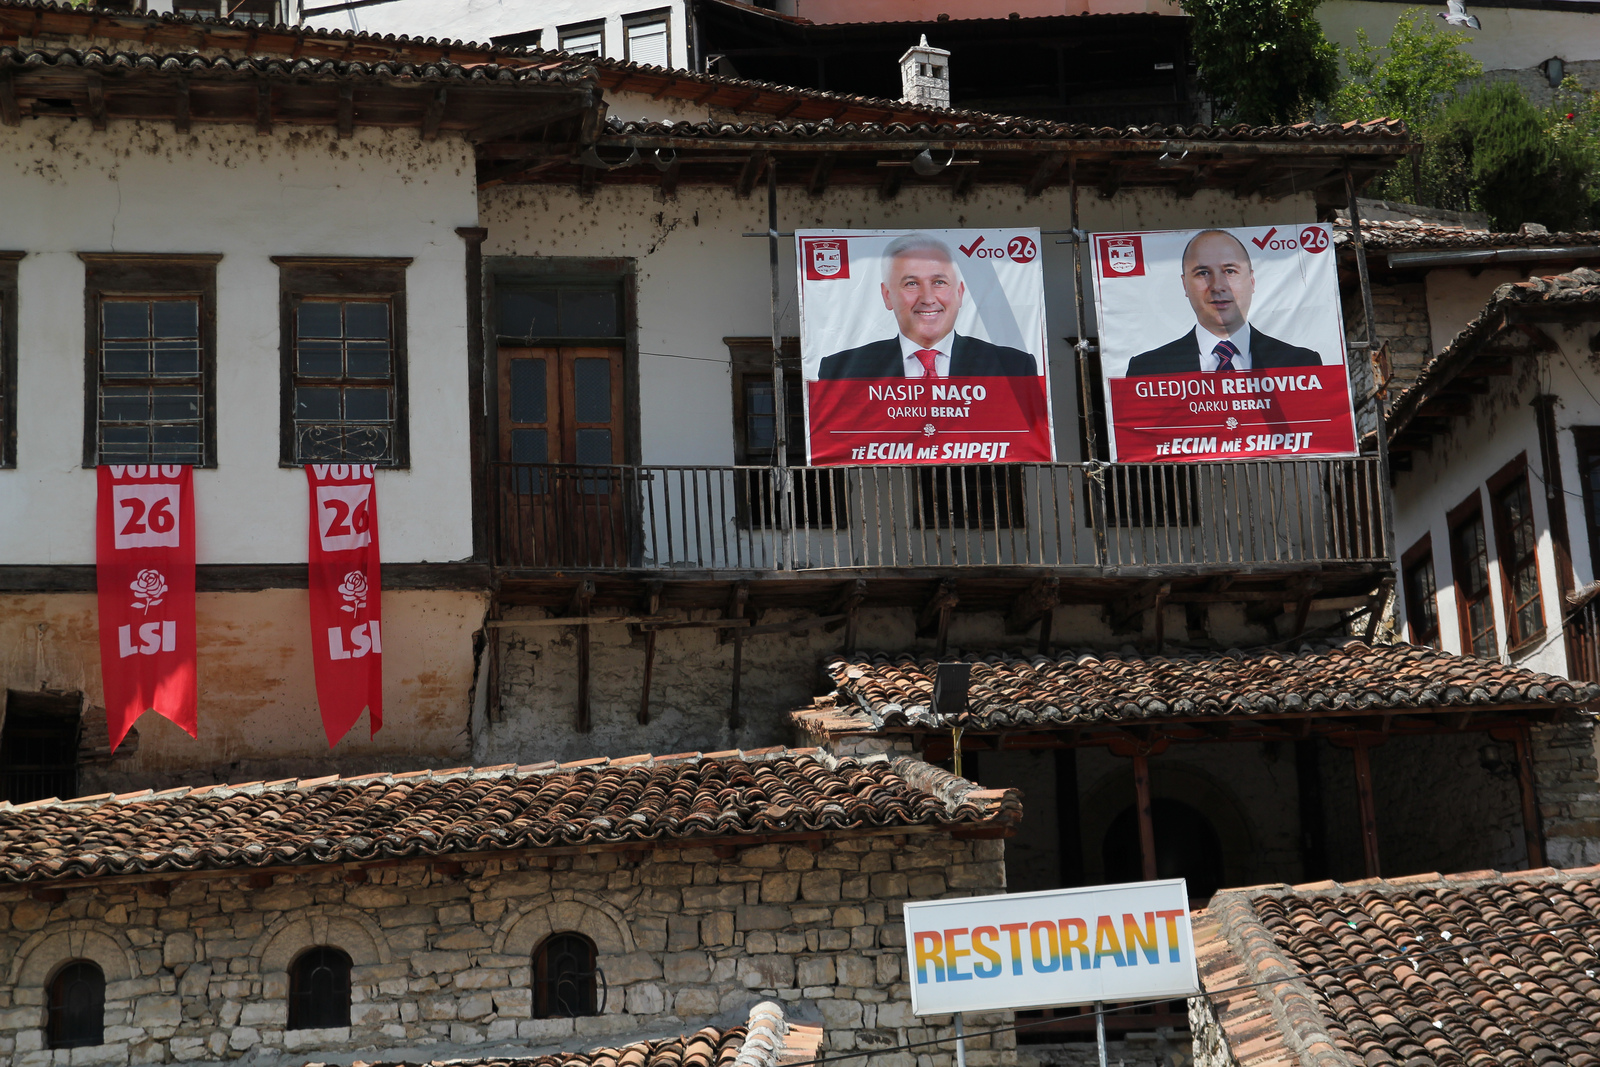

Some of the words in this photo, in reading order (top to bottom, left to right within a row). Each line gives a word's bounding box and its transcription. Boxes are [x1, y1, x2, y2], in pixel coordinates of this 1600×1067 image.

[1010, 241, 1036, 258] 26
[1301, 230, 1328, 248] 26
[868, 385, 925, 401] NASIP
[931, 384, 986, 405] NAÇO
[1135, 379, 1216, 400] GLEDJON
[1221, 374, 1322, 394] REHOVICA
[887, 407, 927, 419] QARKU
[931, 406, 970, 418] BERAT
[1189, 401, 1229, 414] QARKU
[1232, 399, 1271, 411] BERAT
[851, 446, 866, 460] TË
[866, 442, 914, 460] ECIM
[916, 444, 938, 459] MË
[940, 442, 1010, 461] SHPEJT
[1156, 442, 1170, 455] TË
[1171, 437, 1217, 454] ECIM
[1220, 438, 1243, 453] MË
[1245, 432, 1313, 452] SHPEJT
[119, 496, 175, 535] 26
[323, 498, 370, 537] 26
[118, 620, 176, 658] LSI
[327, 620, 382, 660] LSI
[913, 909, 1184, 985] RESTORANT
